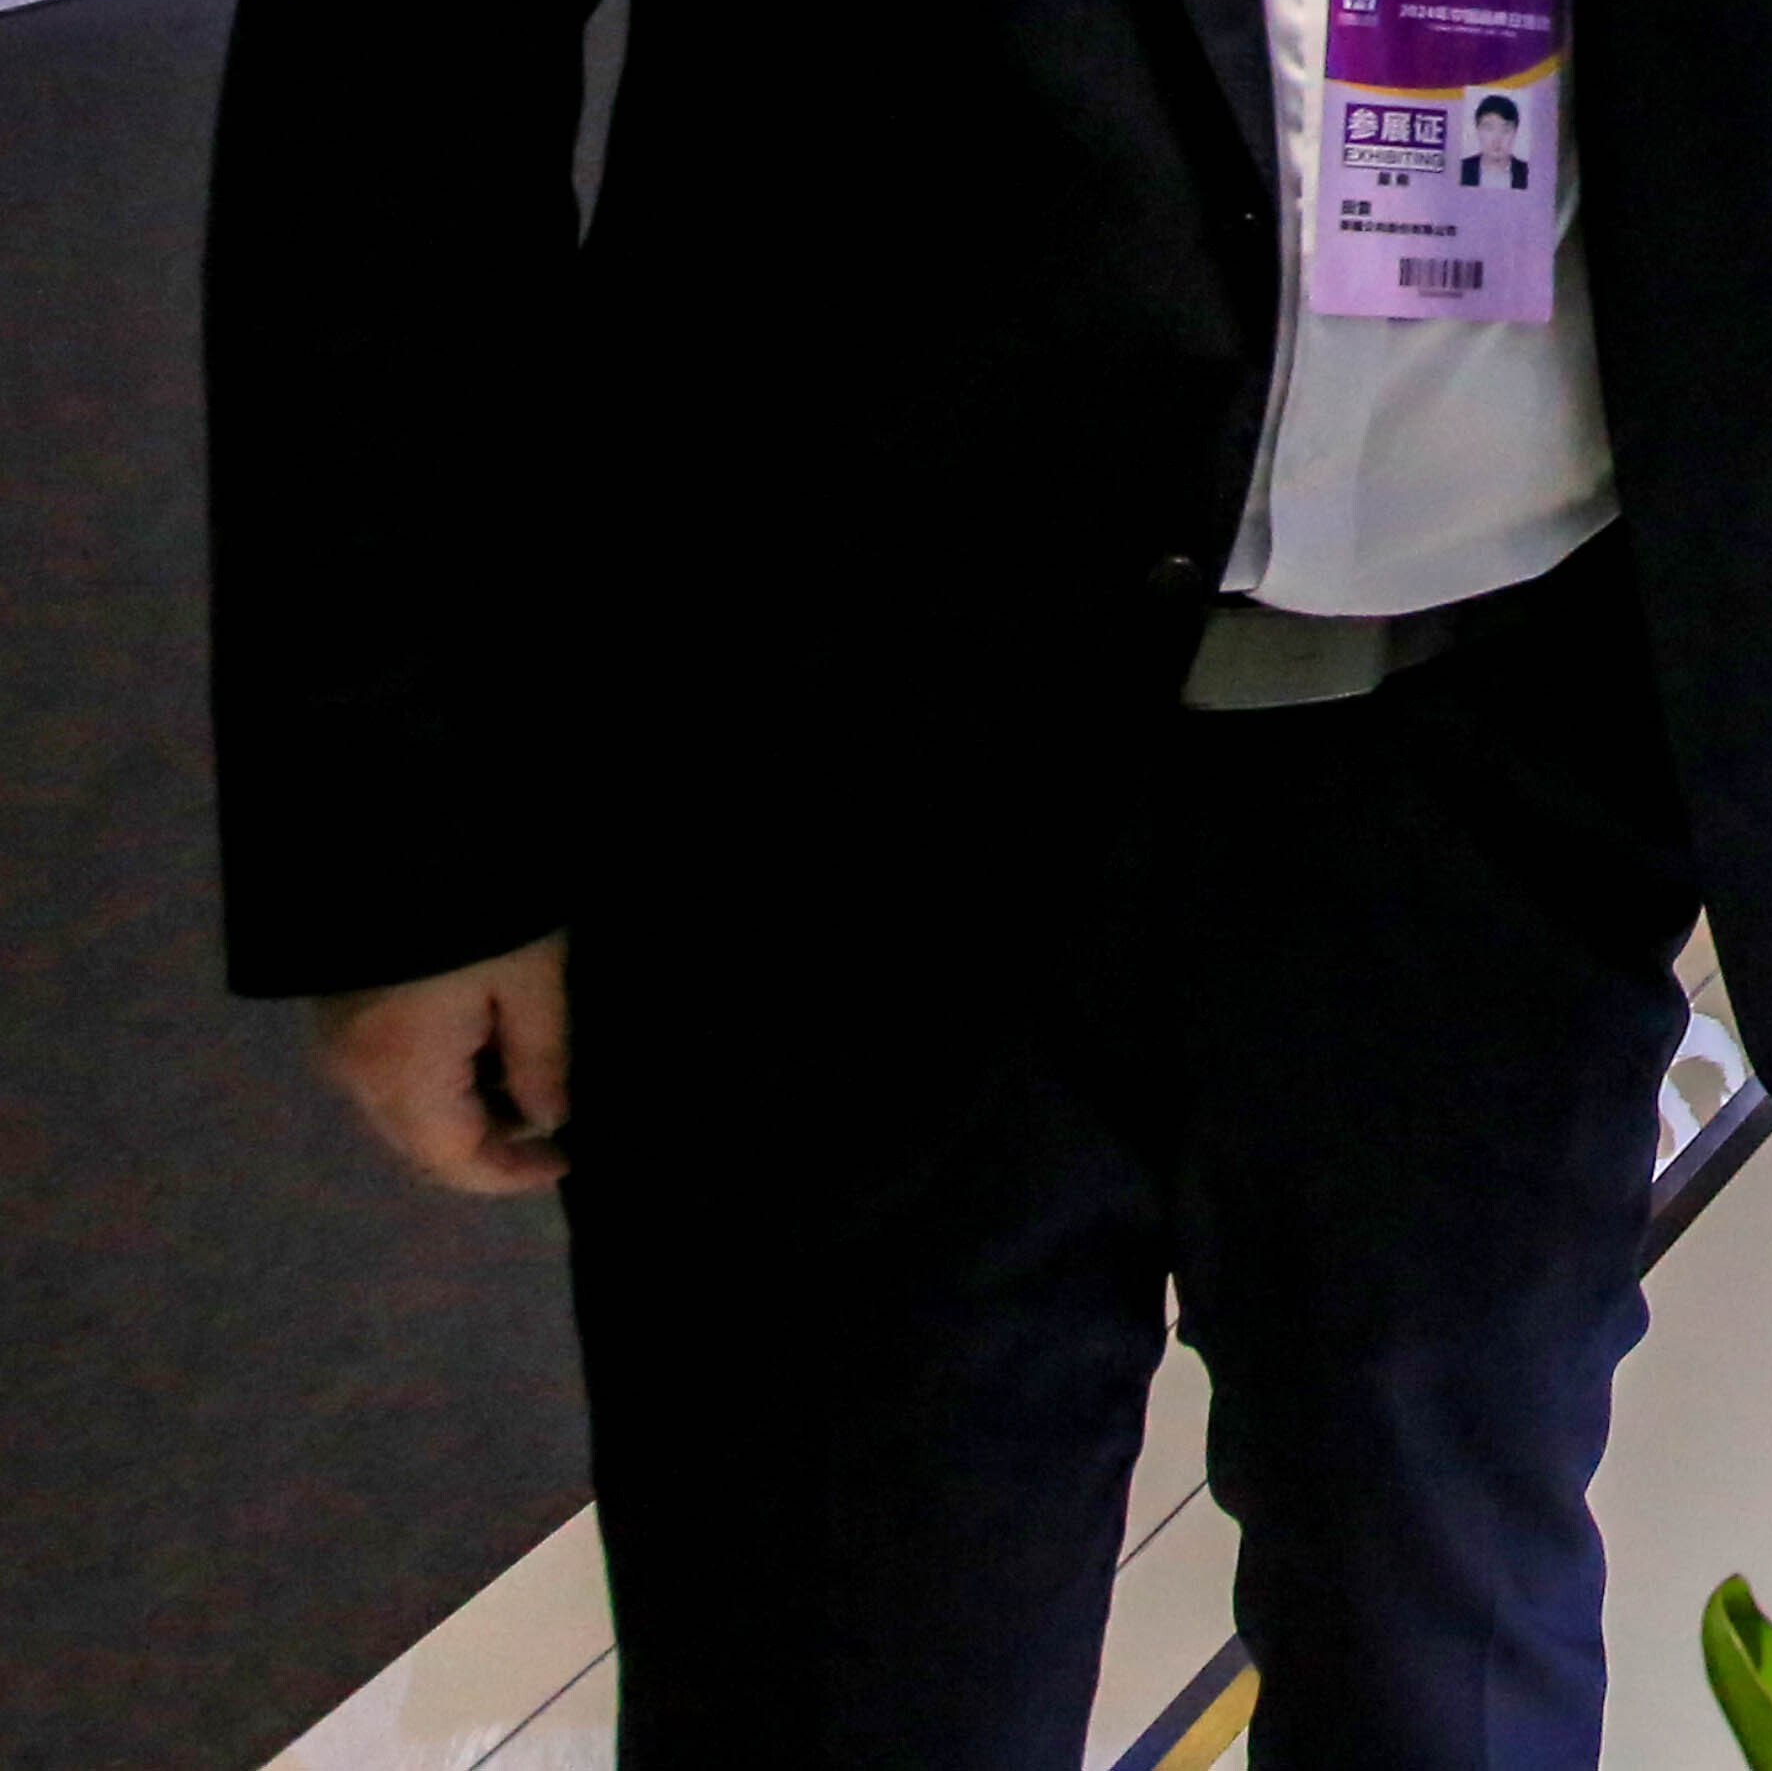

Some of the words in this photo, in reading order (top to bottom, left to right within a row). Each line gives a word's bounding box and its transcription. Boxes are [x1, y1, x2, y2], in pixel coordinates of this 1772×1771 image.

[1346, 108, 1446, 145] 参展证
[1344, 147, 1445, 169] EXHIBITING
